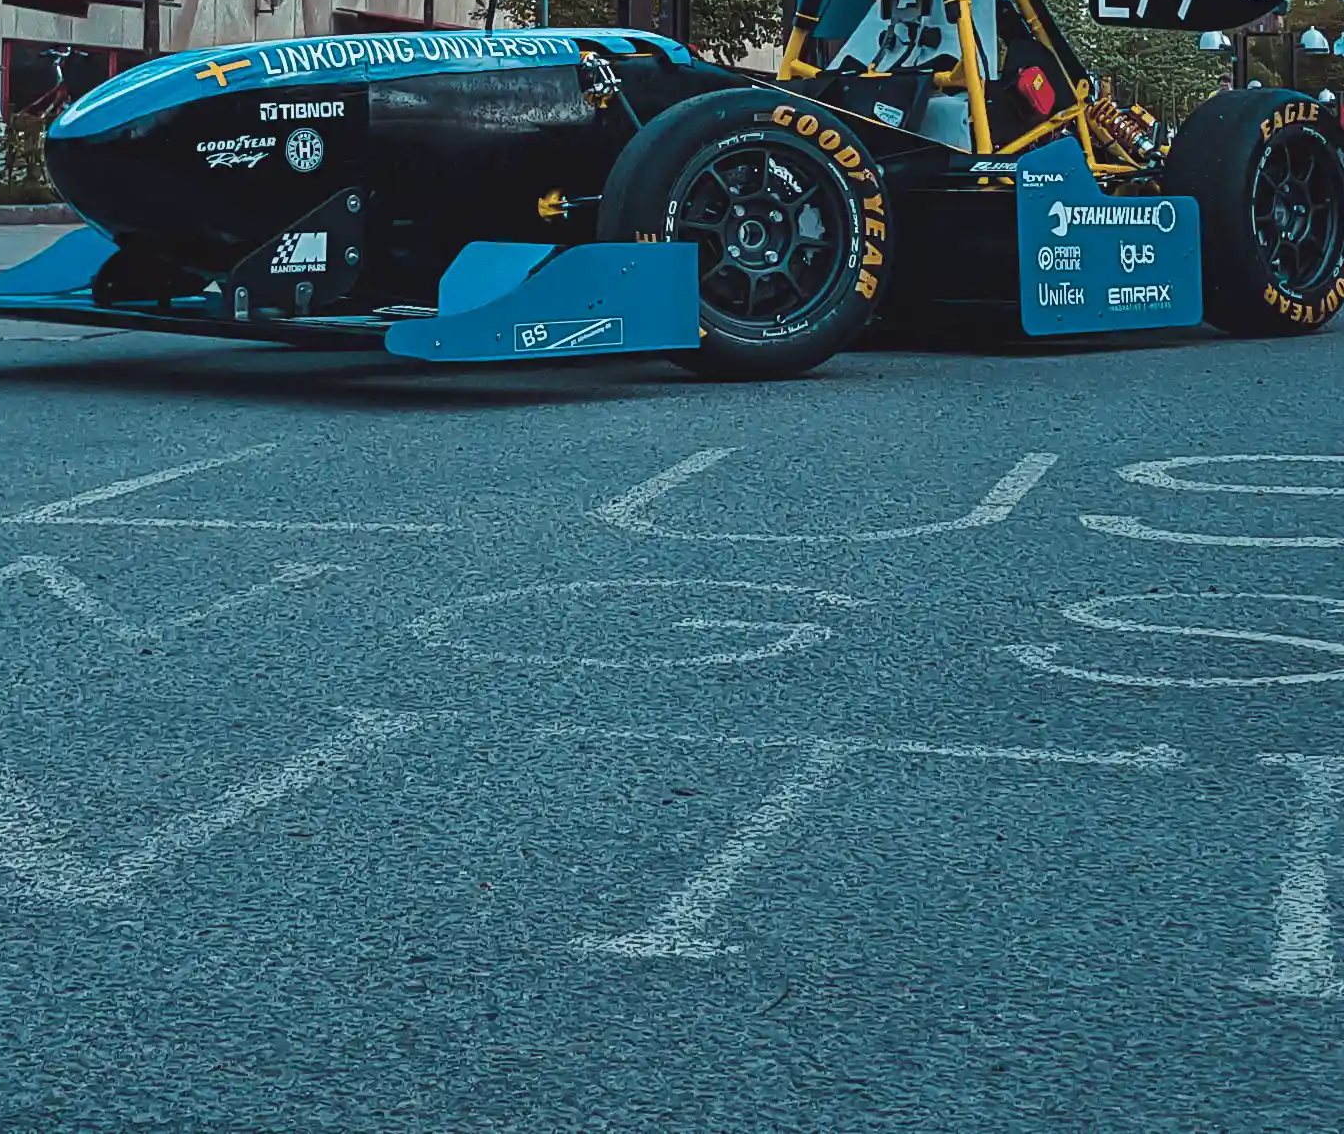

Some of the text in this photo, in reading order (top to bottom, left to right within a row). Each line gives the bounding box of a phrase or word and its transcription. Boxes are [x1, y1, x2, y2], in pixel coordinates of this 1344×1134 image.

[259, 37, 575, 76] LINKÖPING UNIVERSITY
[278, 101, 345, 120] TIBNOR
[1260, 101, 1320, 143] EAGLE
[1119, 239, 1155, 273] igus
[1108, 284, 1171, 305] EMRAX
[520, 322, 548, 348] BS
